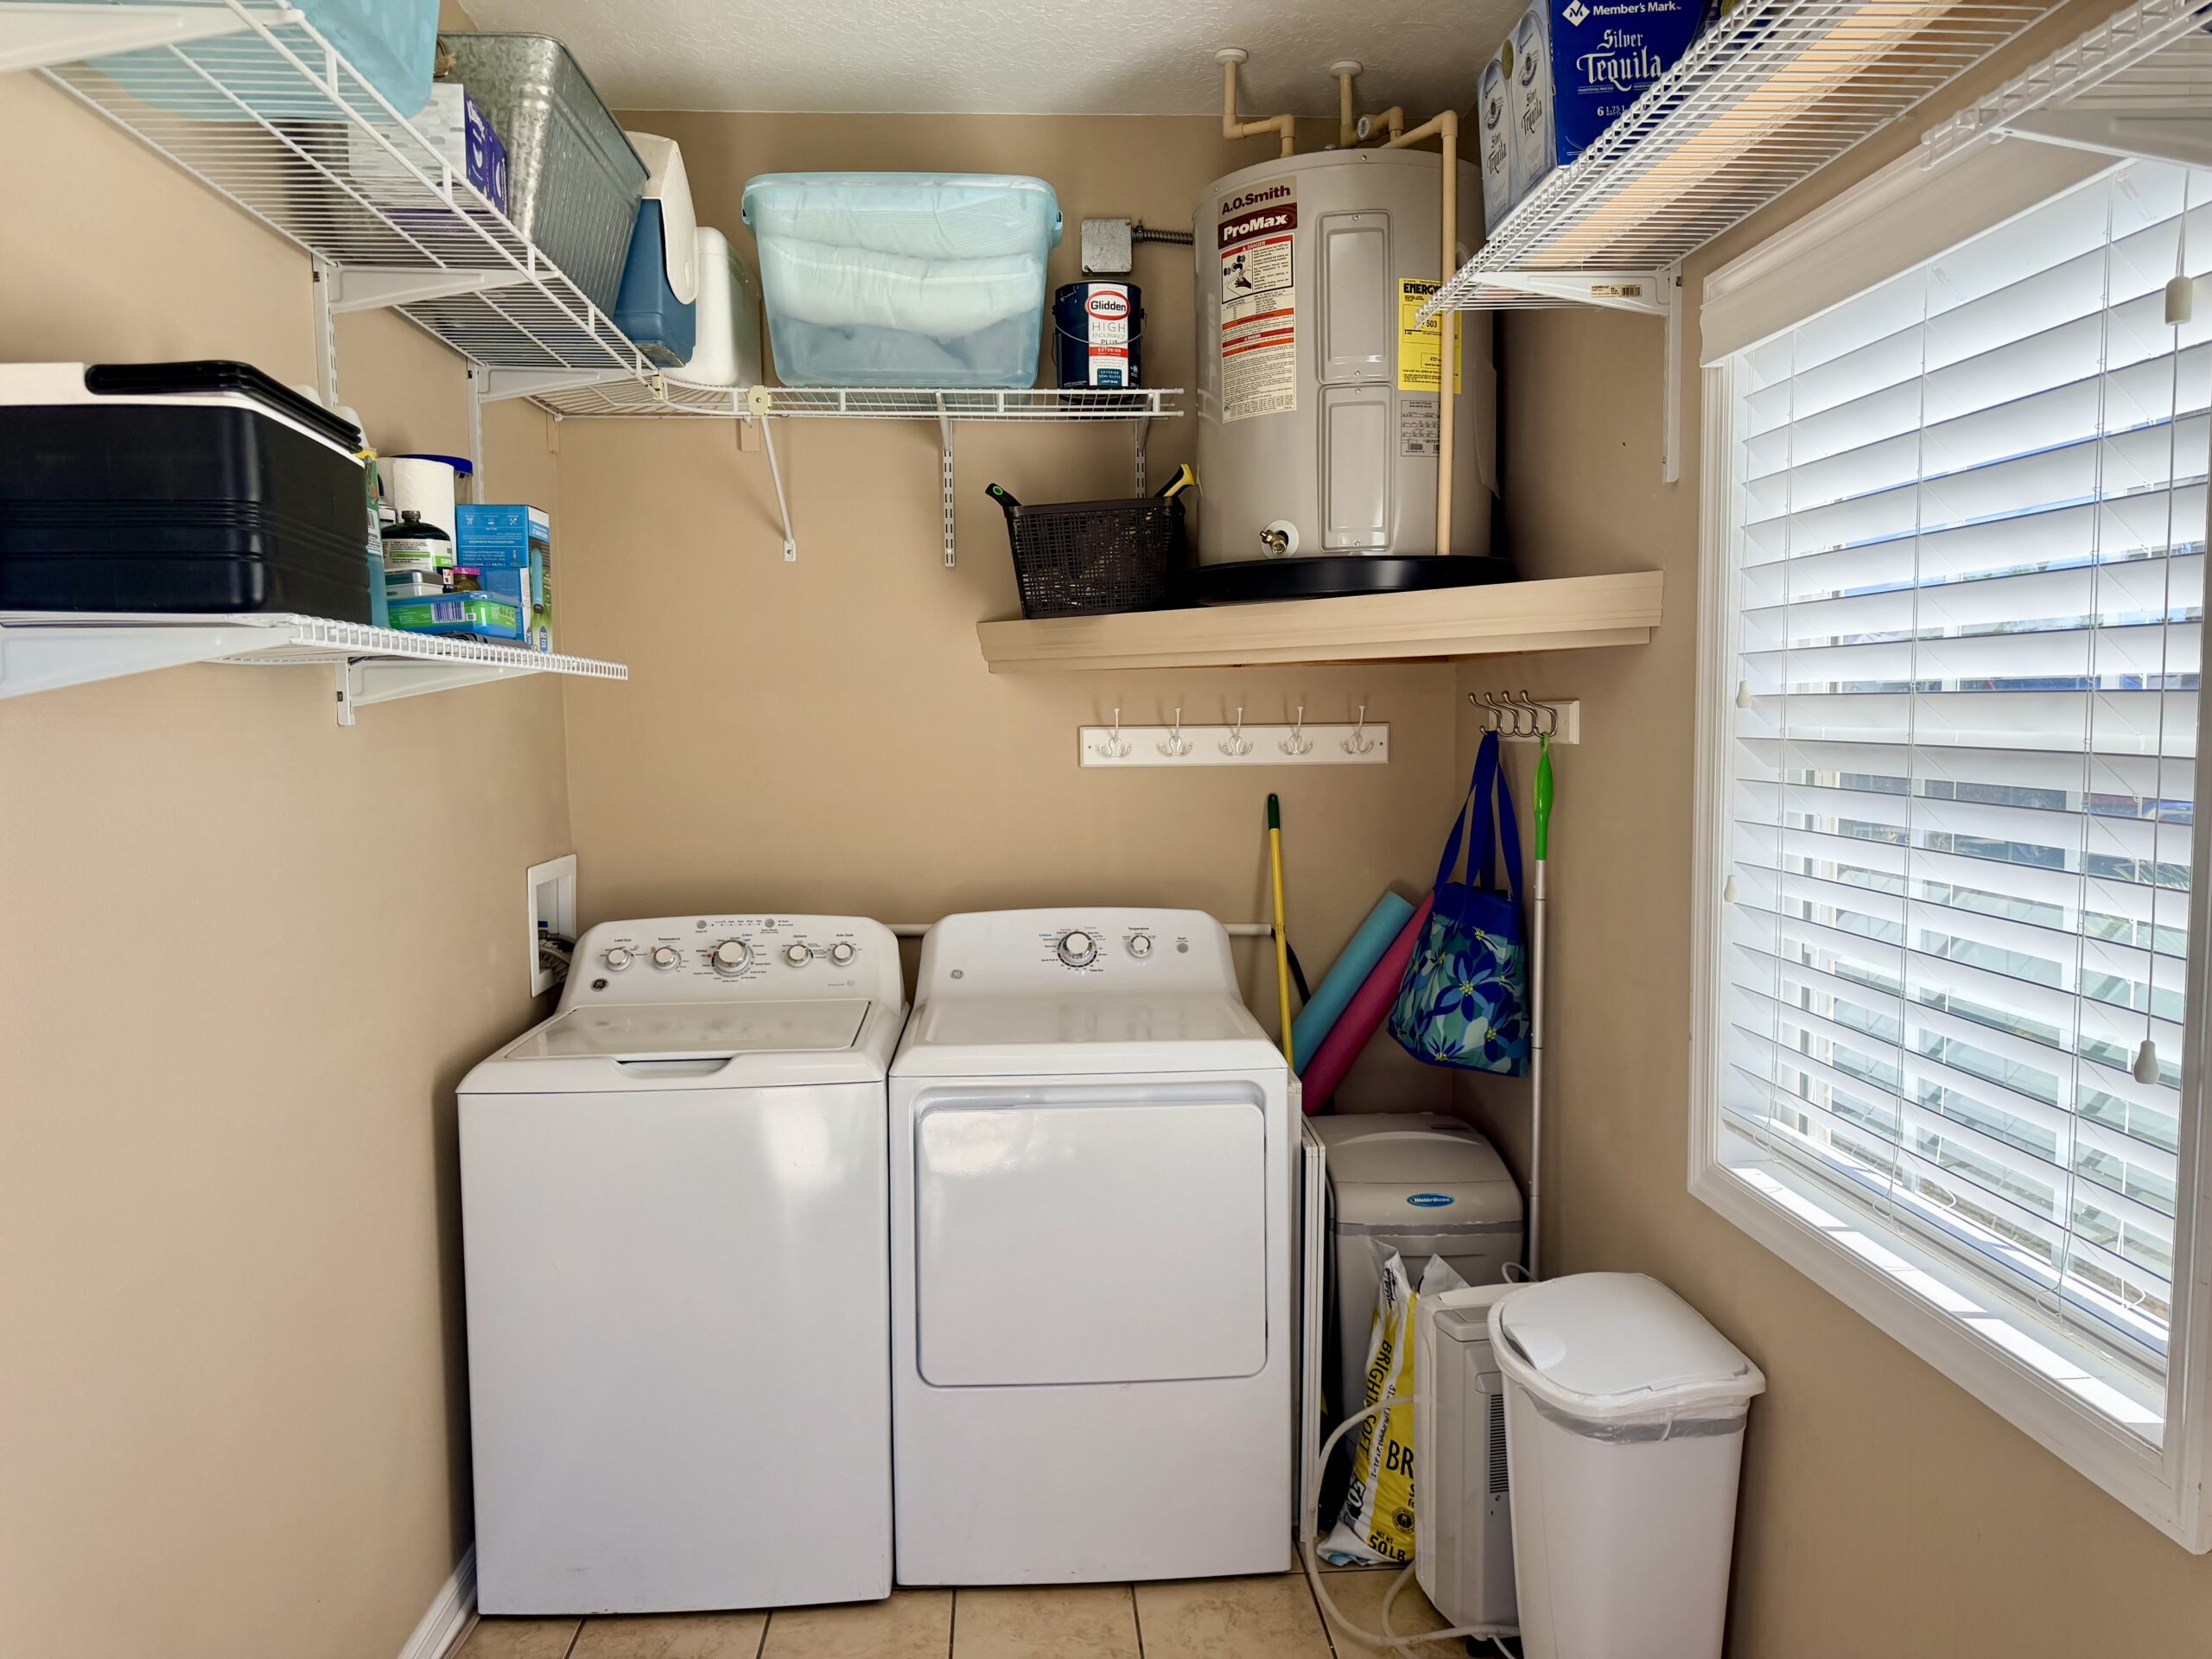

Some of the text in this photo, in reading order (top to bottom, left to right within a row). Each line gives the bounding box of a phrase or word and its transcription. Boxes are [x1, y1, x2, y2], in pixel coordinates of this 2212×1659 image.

[1592, 3, 1645, 16] Member's
[1597, 29, 1643, 50] Silver
[1576, 45, 1663, 92] Tequila
[1597, 106, 1605, 116] 6
[1224, 214, 1287, 241] ProMax
[1247, 241, 1266, 250] DANGER
[1090, 301, 1126, 311] Glidden
[1092, 322, 1126, 333] HIGH
[1368, 1535, 1388, 1555] 50
